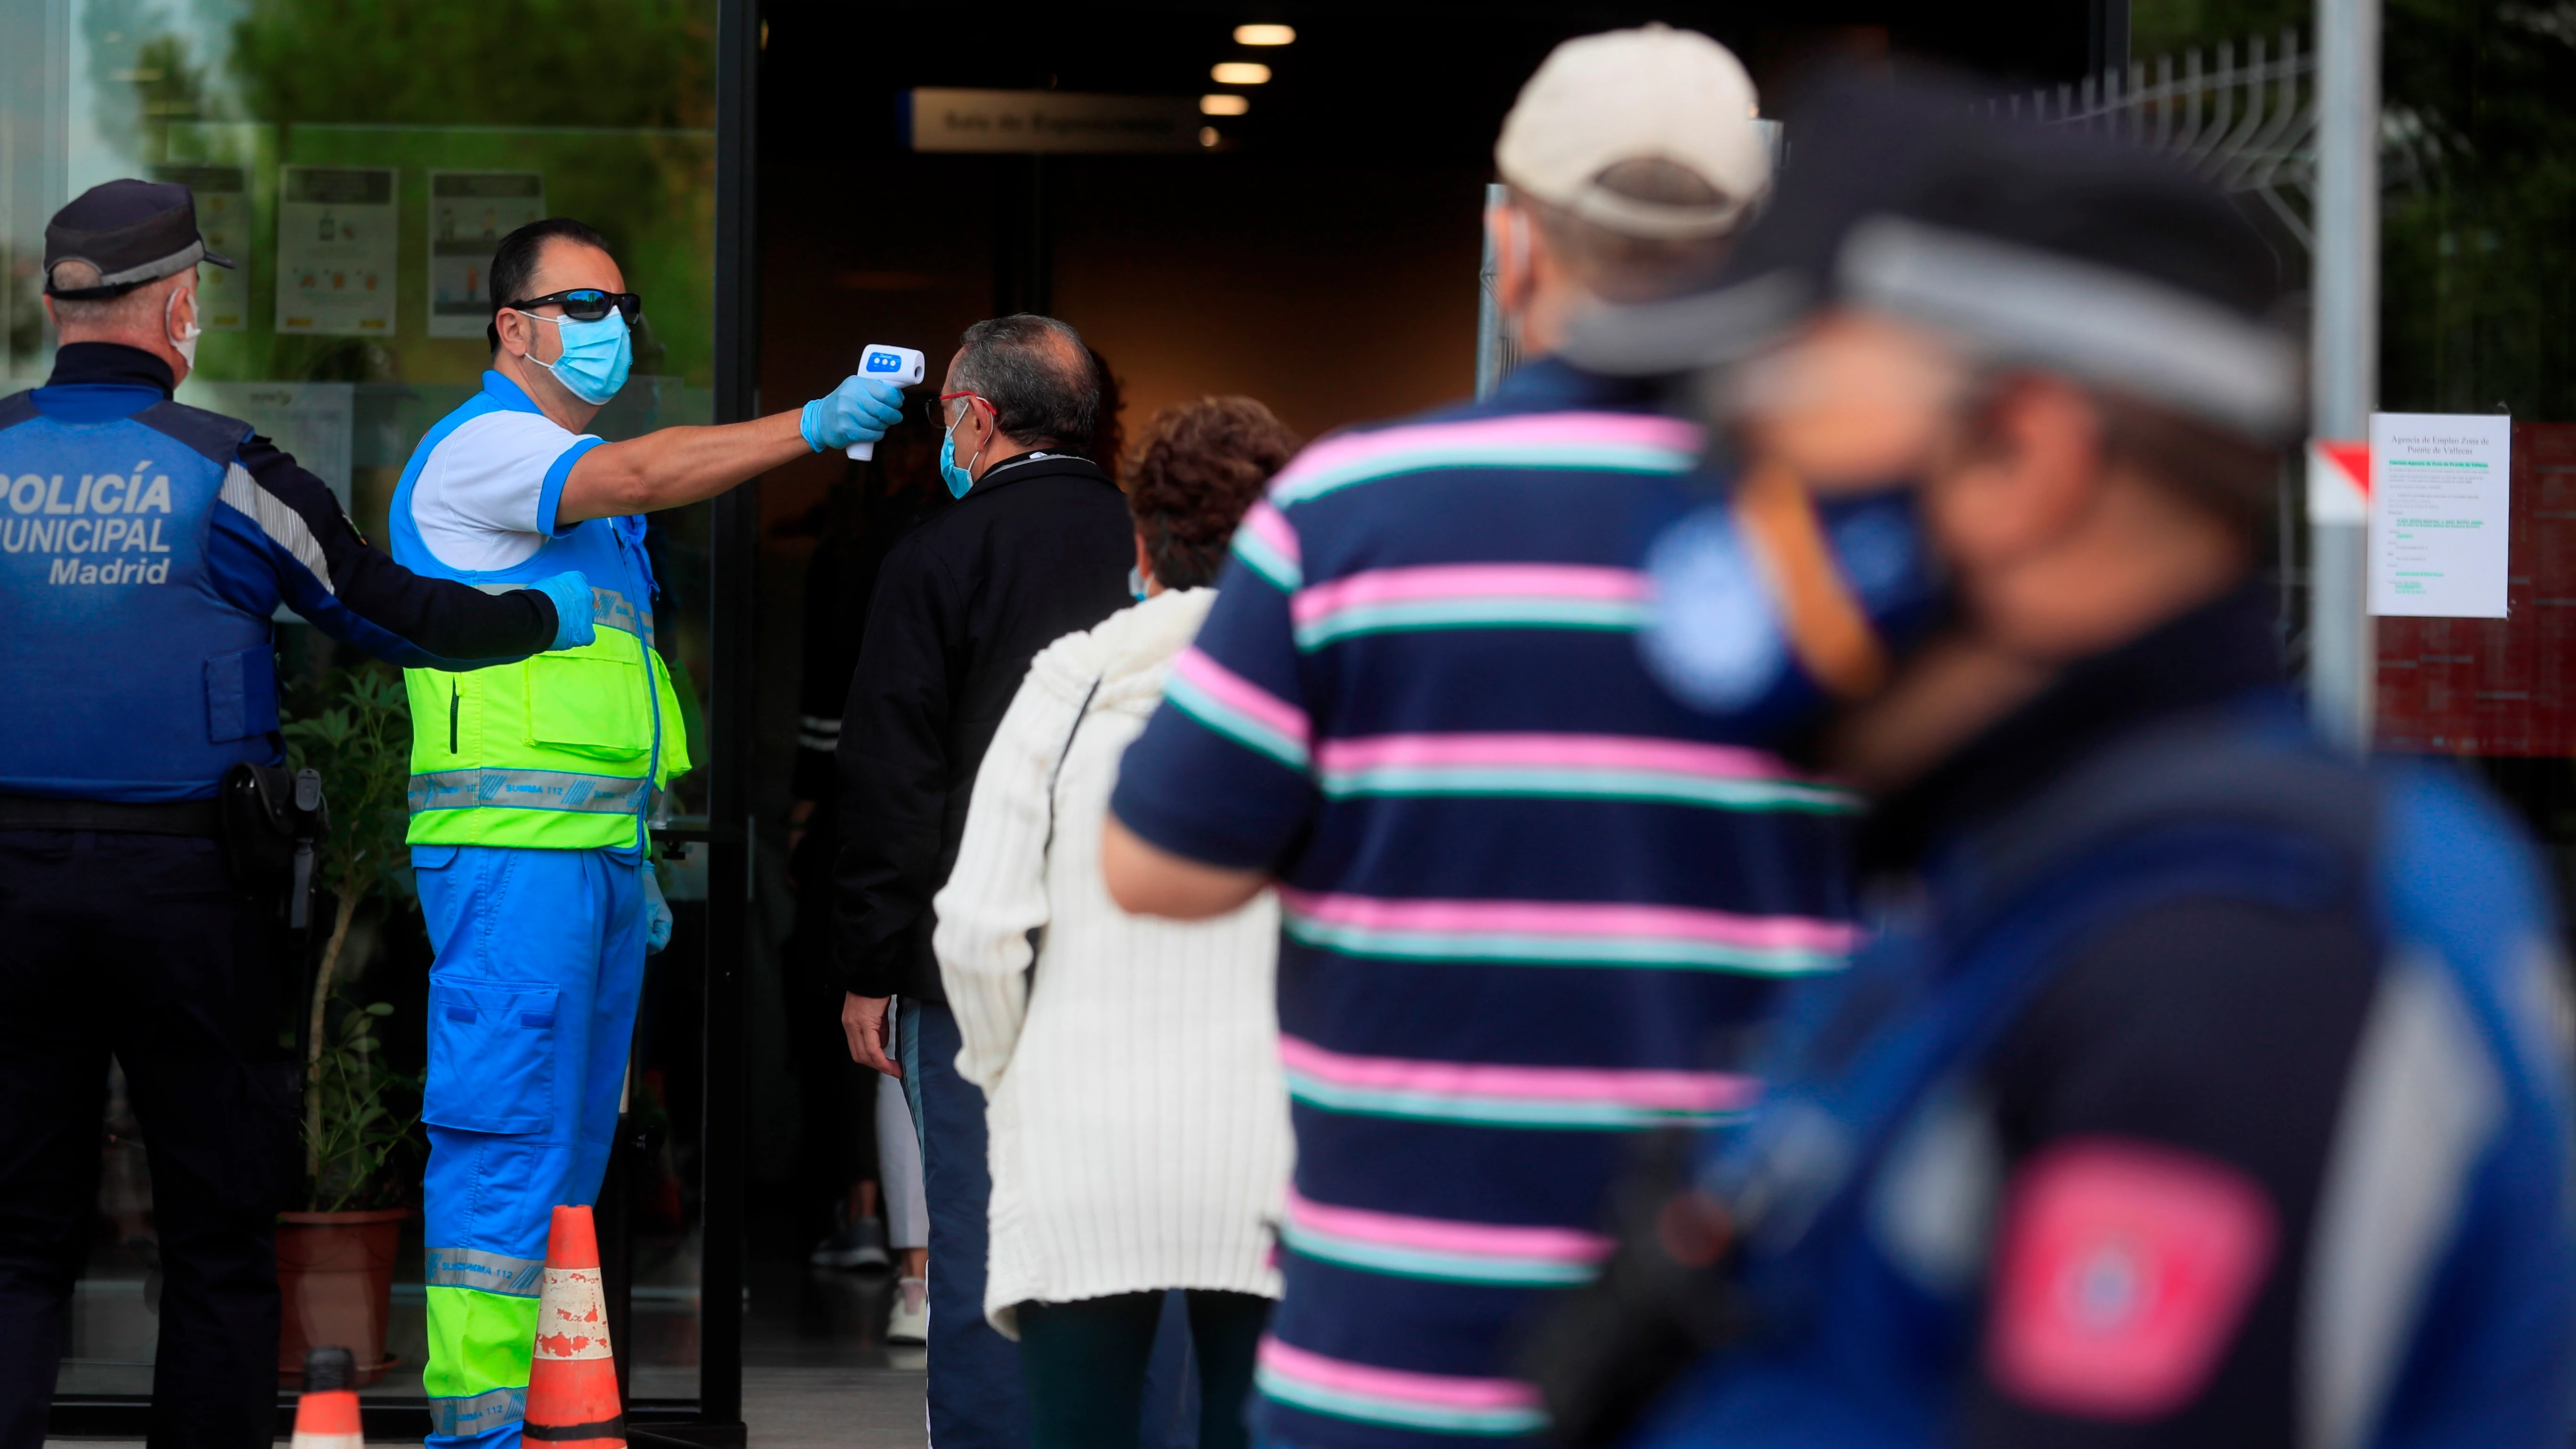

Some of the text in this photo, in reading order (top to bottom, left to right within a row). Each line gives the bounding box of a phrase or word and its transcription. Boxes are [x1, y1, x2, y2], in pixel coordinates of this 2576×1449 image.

[2391, 435, 2420, 445] Agencia
[2433, 436, 2459, 446] Empleo
[2461, 437, 2479, 445] Zona
[2481, 437, 2489, 445] de
[2444, 446, 2473, 455] Vallecas
[0, 519, 171, 554] UNICIPAL
[48, 558, 171, 585] Madrid
[497, 1269, 513, 1279] 112
[487, 1405, 503, 1415] 112
